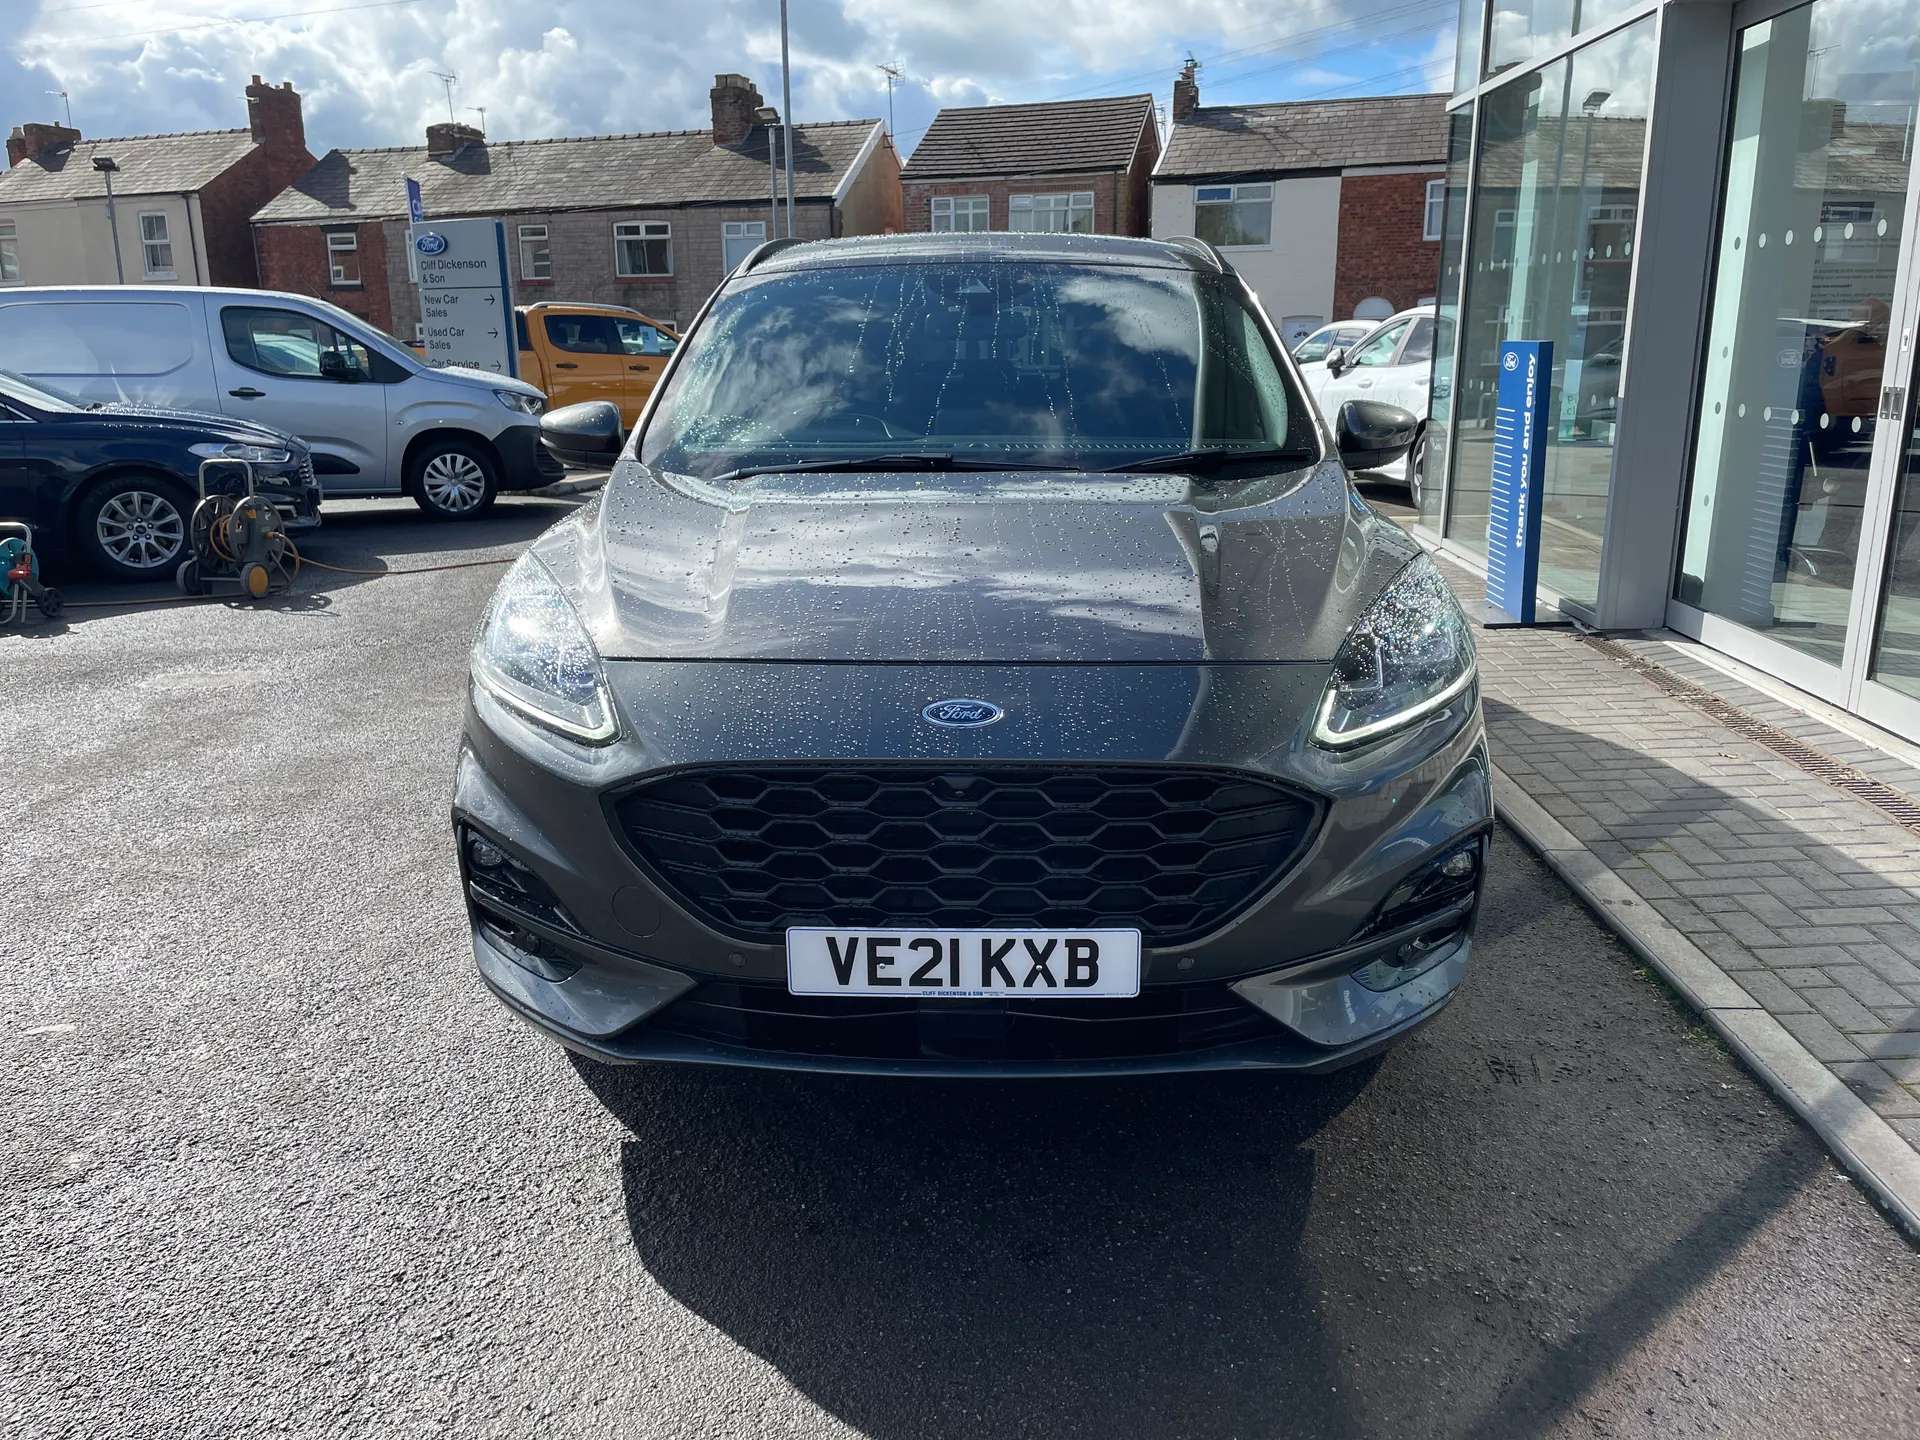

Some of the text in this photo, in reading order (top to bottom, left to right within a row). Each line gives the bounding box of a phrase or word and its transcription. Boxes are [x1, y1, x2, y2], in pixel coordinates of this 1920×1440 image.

[420, 237, 439, 251] Ford
[421, 258, 487, 271] Cliff Dickenson
[422, 273, 445, 283] & Son
[424, 294, 459, 304] New Car
[426, 307, 448, 318] Sales
[427, 326, 465, 337] Used Car
[429, 340, 451, 350] Sales
[432, 358, 480, 369] Car Service
[1516, 353, 1536, 548] thank you and enjoy
[940, 704, 983, 719] Ford
[826, 936, 1100, 988] VE21 KXB
